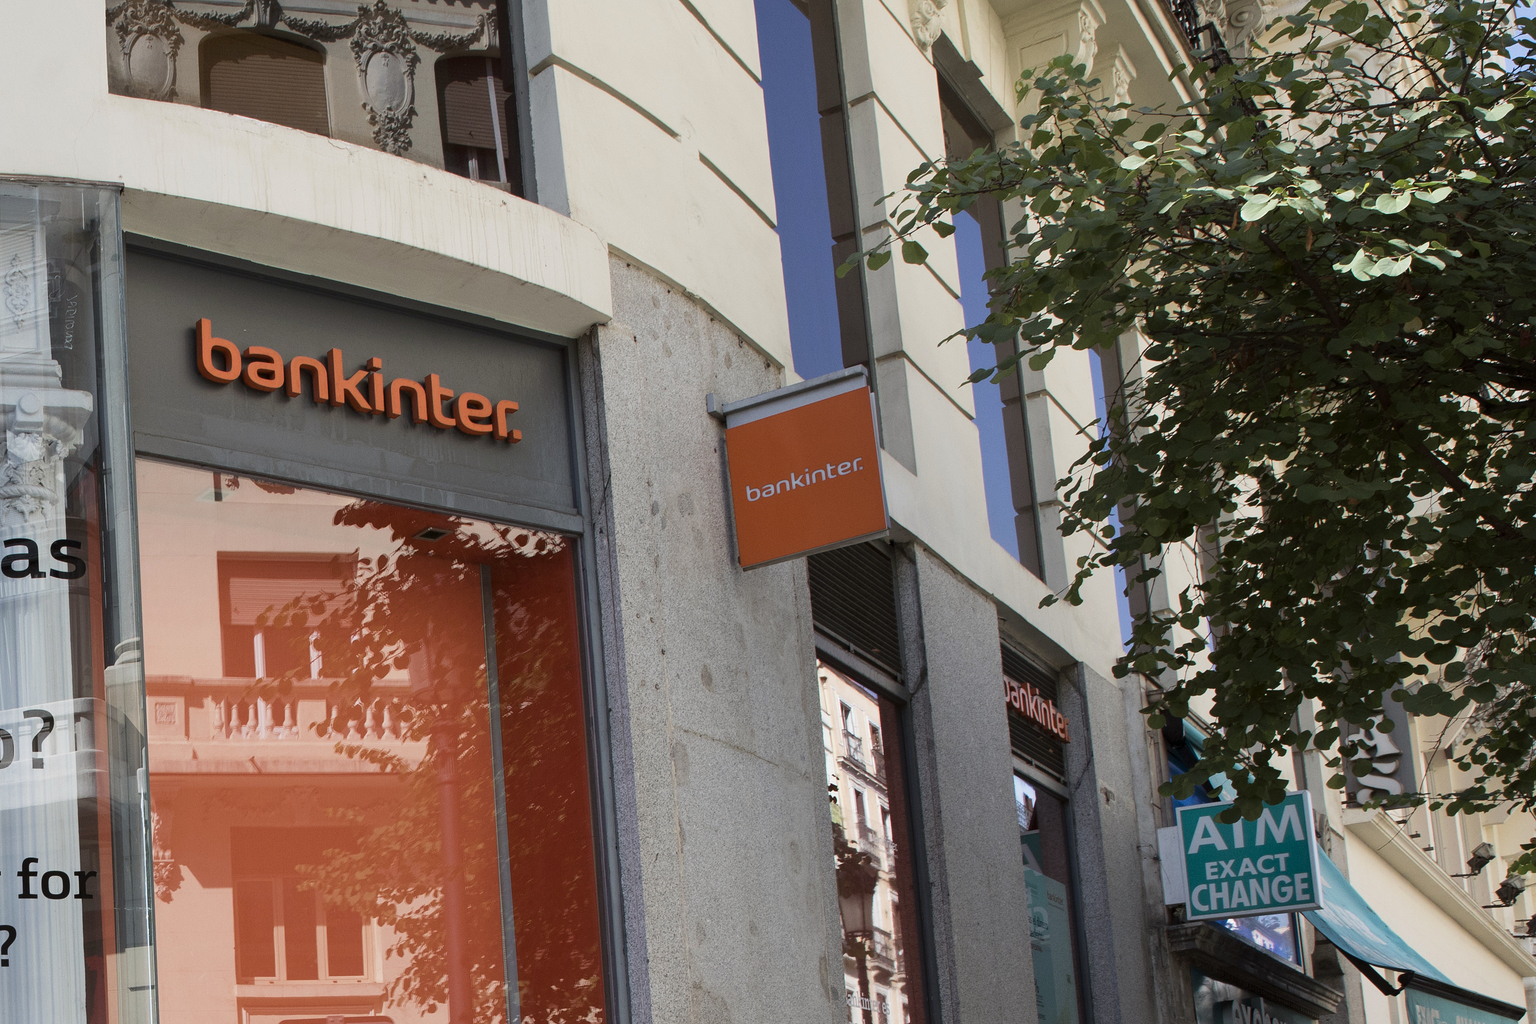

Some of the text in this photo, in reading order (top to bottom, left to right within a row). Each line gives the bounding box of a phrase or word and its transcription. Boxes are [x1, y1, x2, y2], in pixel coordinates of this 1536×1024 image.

[196, 318, 522, 443] bankinter.
[745, 457, 864, 502] bankinter.
[17, 856, 97, 900] for
[1205, 852, 1290, 880] EXACT
[1191, 872, 1311, 912] CHANGE
[847, 991, 880, 1012] ankinter
